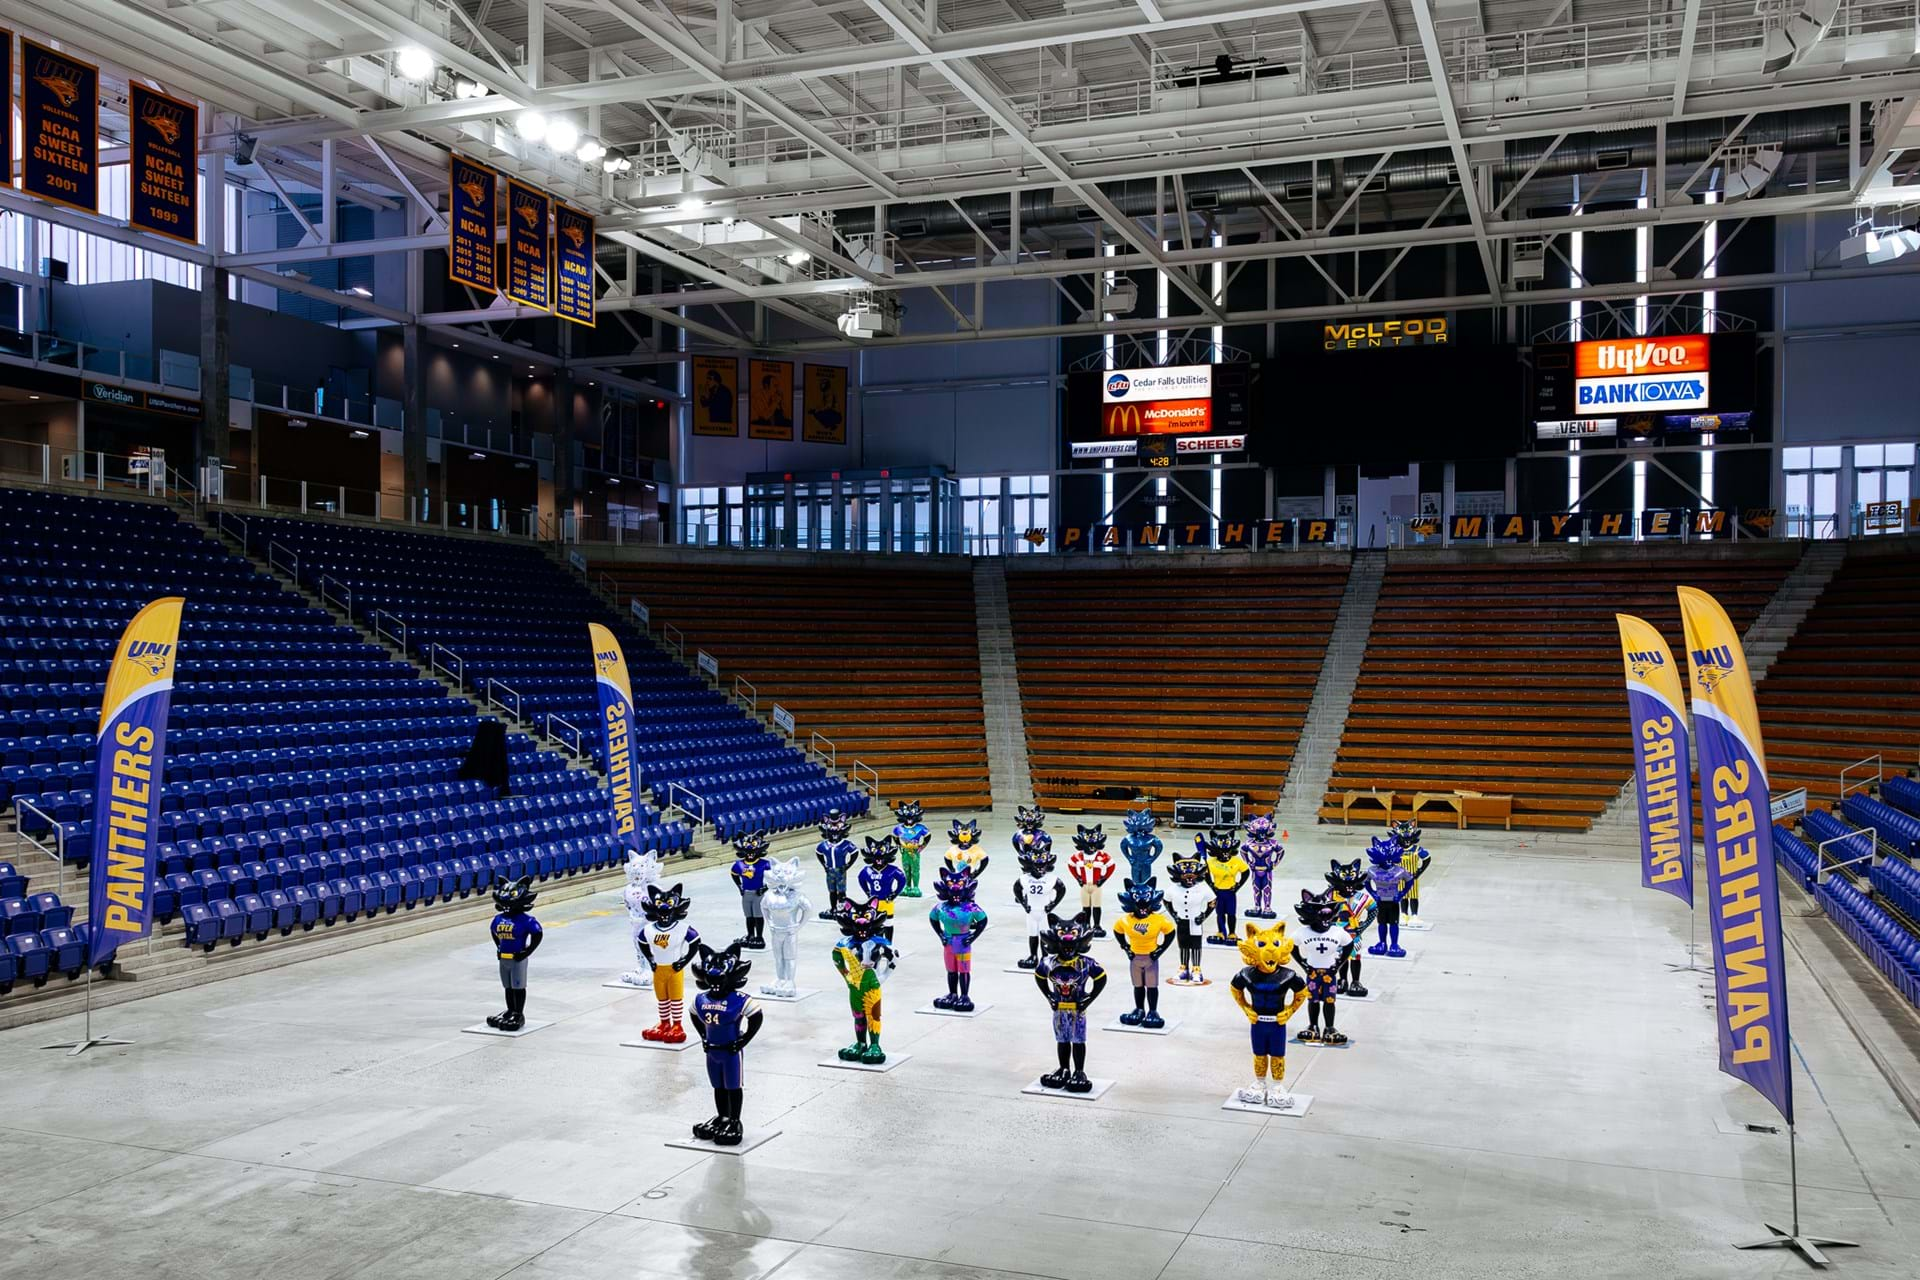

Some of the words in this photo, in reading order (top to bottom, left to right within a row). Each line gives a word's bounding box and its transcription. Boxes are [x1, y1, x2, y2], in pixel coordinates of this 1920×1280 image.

[42, 119, 80, 143] NCAA
[39, 133, 82, 158] SWEET
[33, 145, 88, 175] SIXTEEN
[145, 154, 184, 178] NCAA
[46, 174, 78, 193] 2001
[145, 169, 184, 192] SWEET
[140, 181, 189, 207] SIXTEEN
[149, 206, 179, 224] 1999
[460, 218, 487, 238] NCAA
[517, 240, 541, 259] NCAA
[564, 260, 587, 277] NCAA
[1133, 378, 1157, 388] Cedar
[1158, 376, 1175, 386] Falls
[1176, 375, 1208, 385] Utilities
[93, 384, 134, 403] Veridian
[1144, 407, 1207, 419] McDonald's
[1560, 420, 1598, 434] VENU
[1177, 438, 1242, 452] SCHEELS
[1150, 456, 1170, 467] 4:28
[1411, 518, 1438, 531] UNI
[127, 640, 171, 660] UNI
[105, 721, 155, 933] PANTHERS
[873, 881, 882, 892] 8
[1029, 885, 1044, 895] 32
[654, 934, 671, 945] UNI
[1304, 937, 1339, 946] LIFEGUARD
[705, 1012, 720, 1026] 34
